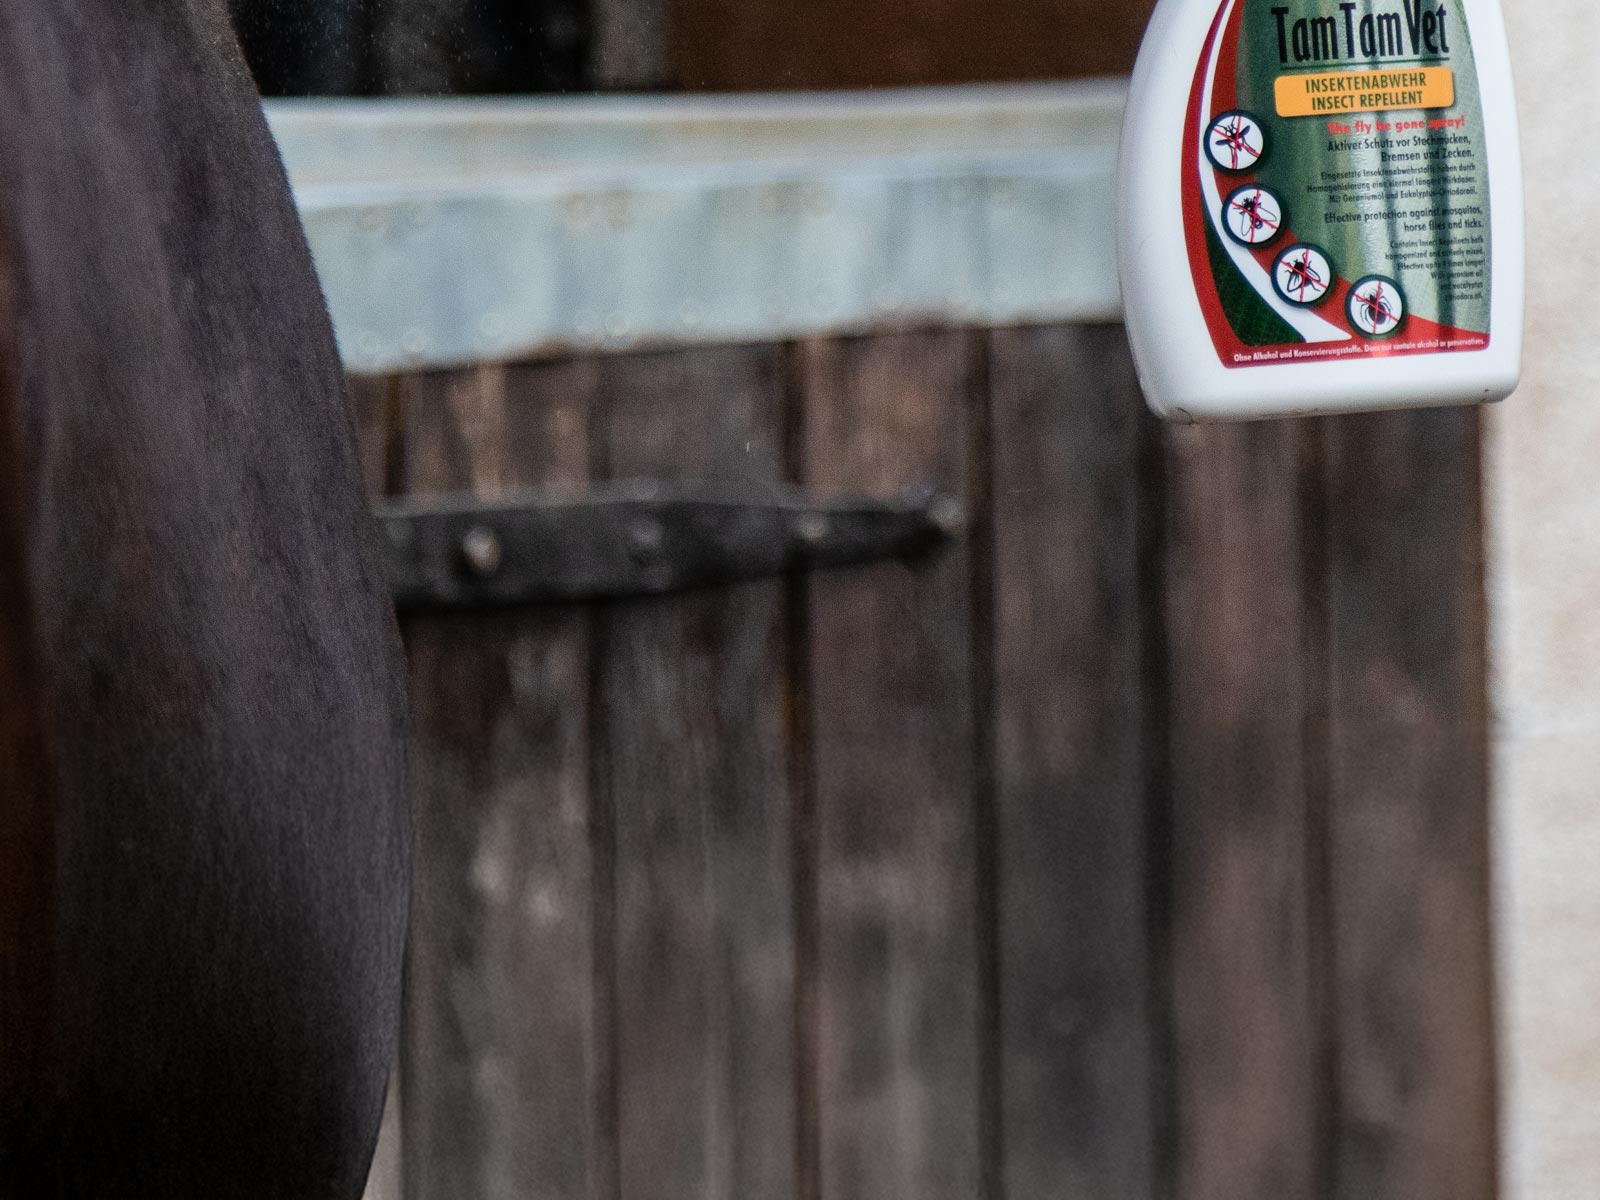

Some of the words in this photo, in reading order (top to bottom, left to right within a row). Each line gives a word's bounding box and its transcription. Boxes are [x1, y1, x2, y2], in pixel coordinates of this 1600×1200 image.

[1305, 72, 1427, 94] INSEKTENABWEHR
[1312, 95, 1355, 110] INSECT
[1360, 91, 1423, 107] REPELLENT
[1354, 120, 1372, 134] fly
[1376, 119, 1391, 132] be
[1395, 119, 1425, 132] gone
[1428, 115, 1465, 131] spray!
[1327, 139, 1362, 151] Aktiver
[1364, 137, 1394, 150] Schutz
[1396, 138, 1410, 147] vor
[1381, 151, 1421, 162] Bremsen
[1423, 149, 1439, 159] und
[1443, 147, 1474, 159] Zecken.
[1324, 211, 1362, 224] Effective
[1364, 208, 1407, 222] protection
[1410, 207, 1440, 220] against
[1404, 221, 1427, 232] horse
[1448, 219, 1462, 229] and
[1233, 353, 1251, 362] Ohne
[1253, 351, 1278, 360] Alkohol
[1280, 350, 1292, 358] und
